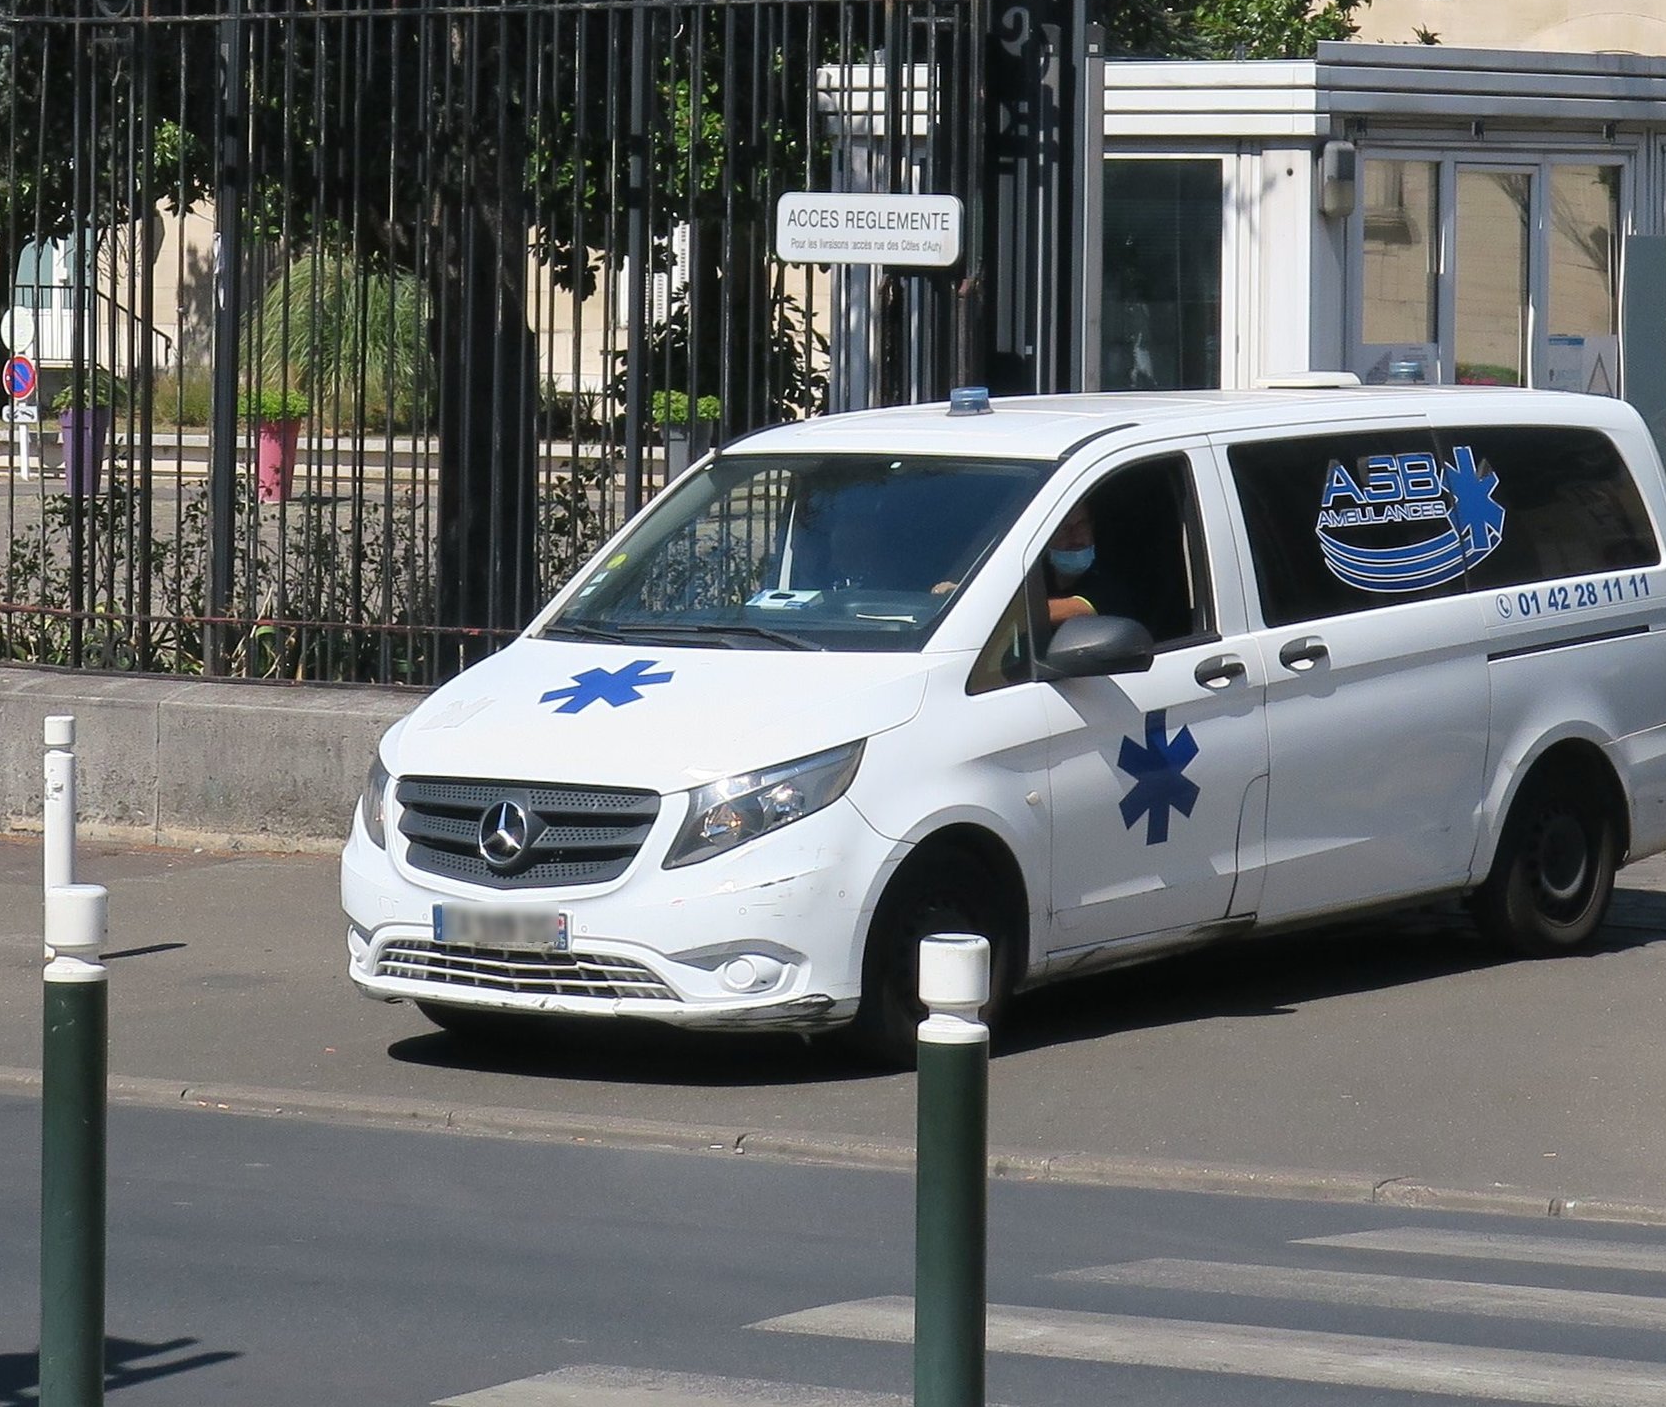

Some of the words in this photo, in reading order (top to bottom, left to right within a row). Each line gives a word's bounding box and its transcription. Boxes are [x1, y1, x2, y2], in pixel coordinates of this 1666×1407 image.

[787, 209, 839, 228] ACCES
[845, 210, 950, 231] REGLEMENTE
[791, 238, 806, 249] Pour
[807, 238, 817, 249] les
[819, 238, 849, 250] livraisons
[873, 241, 884, 250] rue
[888, 239, 899, 250] des
[1322, 452, 1443, 507] ASB
[1317, 500, 1448, 528] AMBULANCES
[1518, 590, 1541, 617] 01
[1548, 586, 1571, 611] 42
[1575, 583, 1598, 607] 28
[1603, 577, 1623, 603] 11
[1629, 573, 1650, 598] 11
